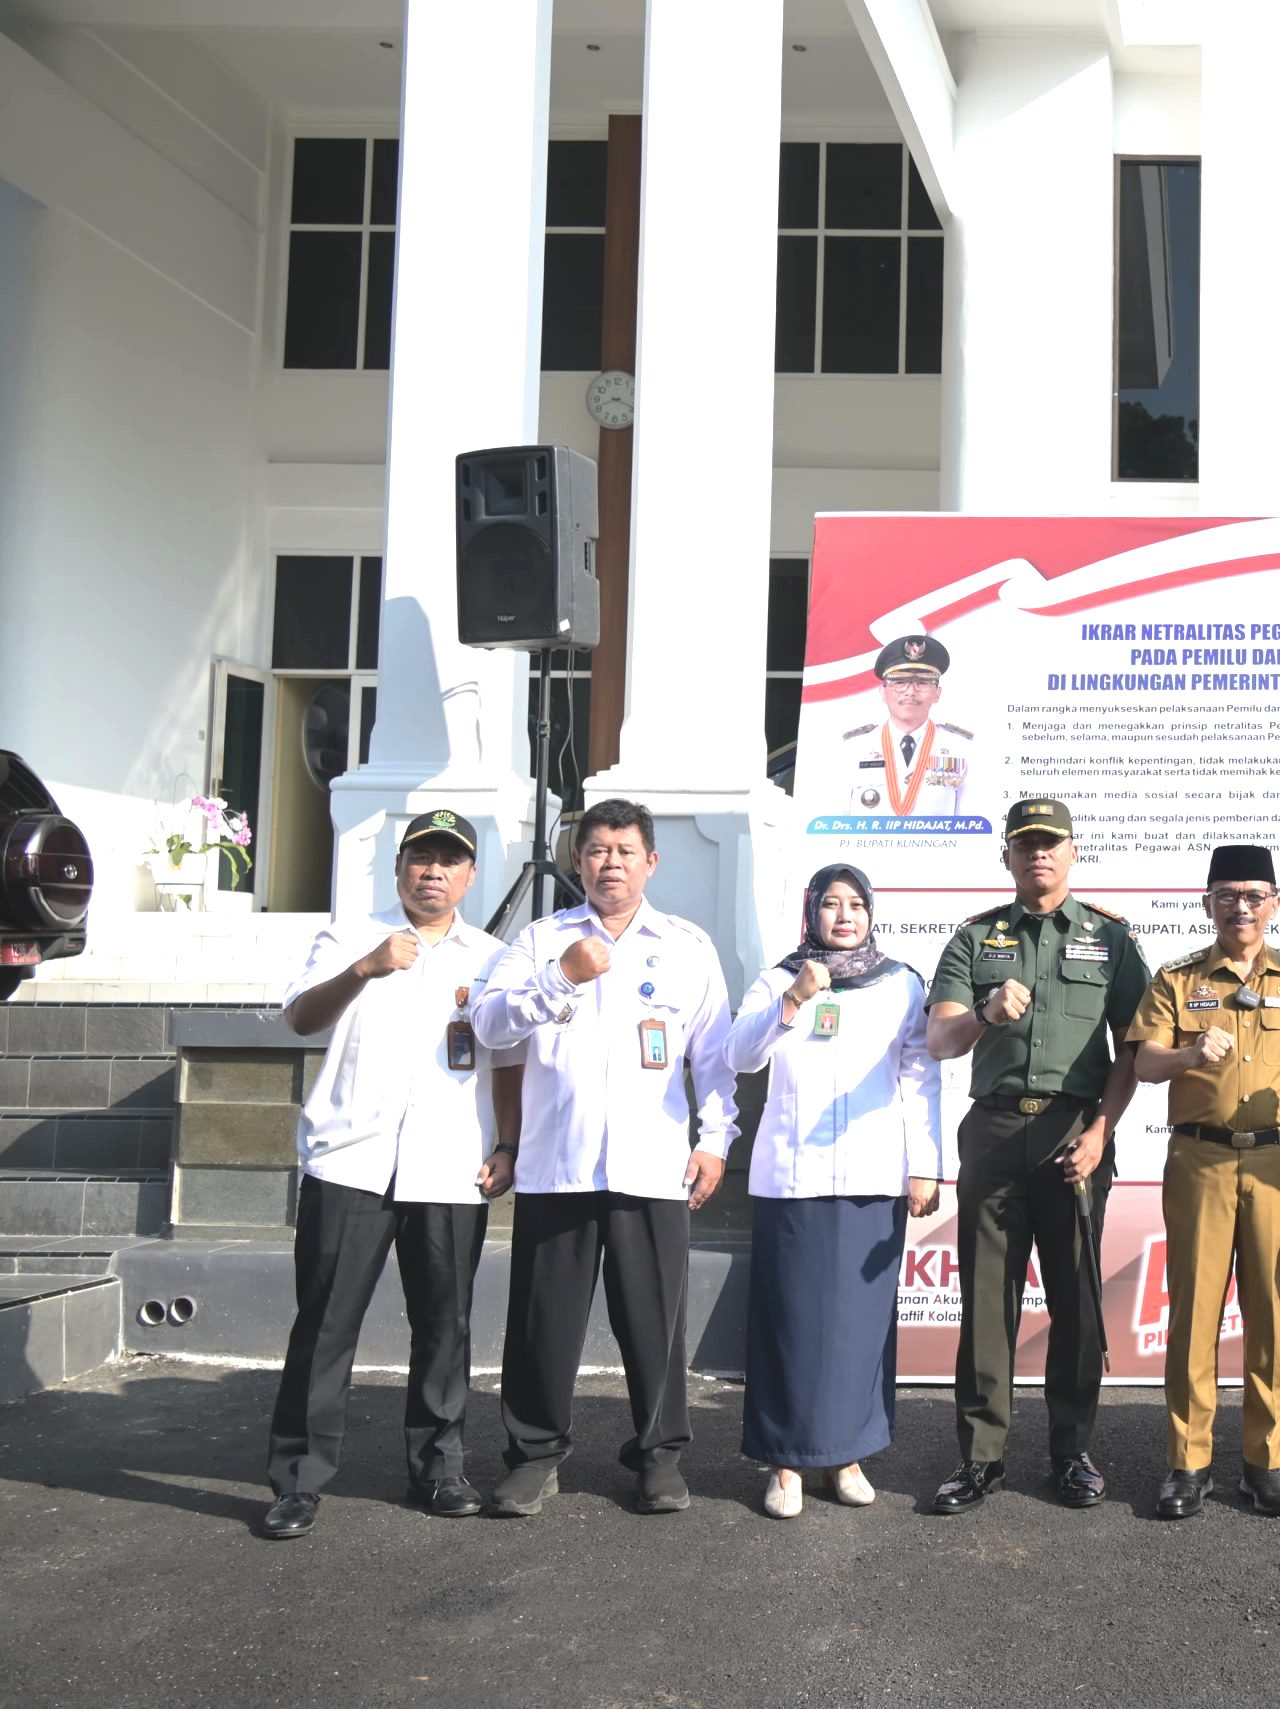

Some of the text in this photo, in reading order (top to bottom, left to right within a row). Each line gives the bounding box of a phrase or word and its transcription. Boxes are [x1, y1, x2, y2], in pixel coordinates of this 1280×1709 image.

[1082, 624, 1136, 640] IKRAR
[1141, 624, 1245, 640] NETRALITAS
[1131, 649, 1177, 666] PADA
[1182, 649, 1247, 665] PEMILU
[1048, 674, 1066, 690] DI
[1071, 674, 1186, 691] LINGKUNGAN
[1007, 704, 1040, 712] Dalam
[1042, 705, 1077, 714] rangka
[1079, 705, 1157, 715] menyukseskan
[1159, 705, 1224, 714] pelaksanaan
[1226, 704, 1262, 712] Pemilu
[1022, 722, 1066, 731] Menjaga
[1072, 722, 1092, 730] dan
[1098, 722, 1164, 732] menegakkan
[1171, 722, 1207, 731] prinsip
[1214, 722, 1263, 730] netralitas
[1022, 733, 1068, 741] sebelum,
[1070, 733, 1109, 741] selama,
[1155, 733, 1199, 741] sesudah
[1201, 733, 1265, 742] pelaksanaan
[1021, 756, 1086, 766] Menghindari
[1089, 756, 1124, 764] konflik
[1128, 756, 1195, 766] kepentingan,
[1199, 756, 1224, 764] tidak
[1020, 768, 1060, 776] seluruh
[1061, 768, 1099, 776] elemen
[1101, 768, 1162, 778] masyarakat
[1164, 768, 1190, 776] serta
[1192, 768, 1218, 776] tidak
[1220, 768, 1267, 776] memihak
[1019, 790, 1097, 800] Menggunakan
[1104, 791, 1137, 799] media
[1145, 791, 1178, 799] sosial
[1229, 790, 1255, 801] bijak
[1072, 814, 1096, 822] olitik
[1099, 816, 1125, 824] uang
[1127, 814, 1147, 822] dan
[1149, 814, 1184, 824] segala
[1185, 815, 1211, 824] jenis
[1213, 814, 1269, 824] pemberian
[814, 821, 829, 830] Dr.
[832, 821, 853, 830] Drs.
[857, 821, 868, 830] H.
[872, 821, 882, 830] R.
[903, 820, 952, 831] HIDAJAT,
[954, 820, 984, 830] M.Pd.
[1111, 831, 1137, 840] kami
[1144, 832, 1168, 840] buat
[1175, 832, 1195, 840] dan
[1202, 831, 1276, 840] dilaksanakan
[1135, 843, 1181, 853] Pegawai
[1187, 843, 1211, 852] ASN
[1152, 900, 1205, 910] Kami yan
[872, 923, 896, 935] ATI,
